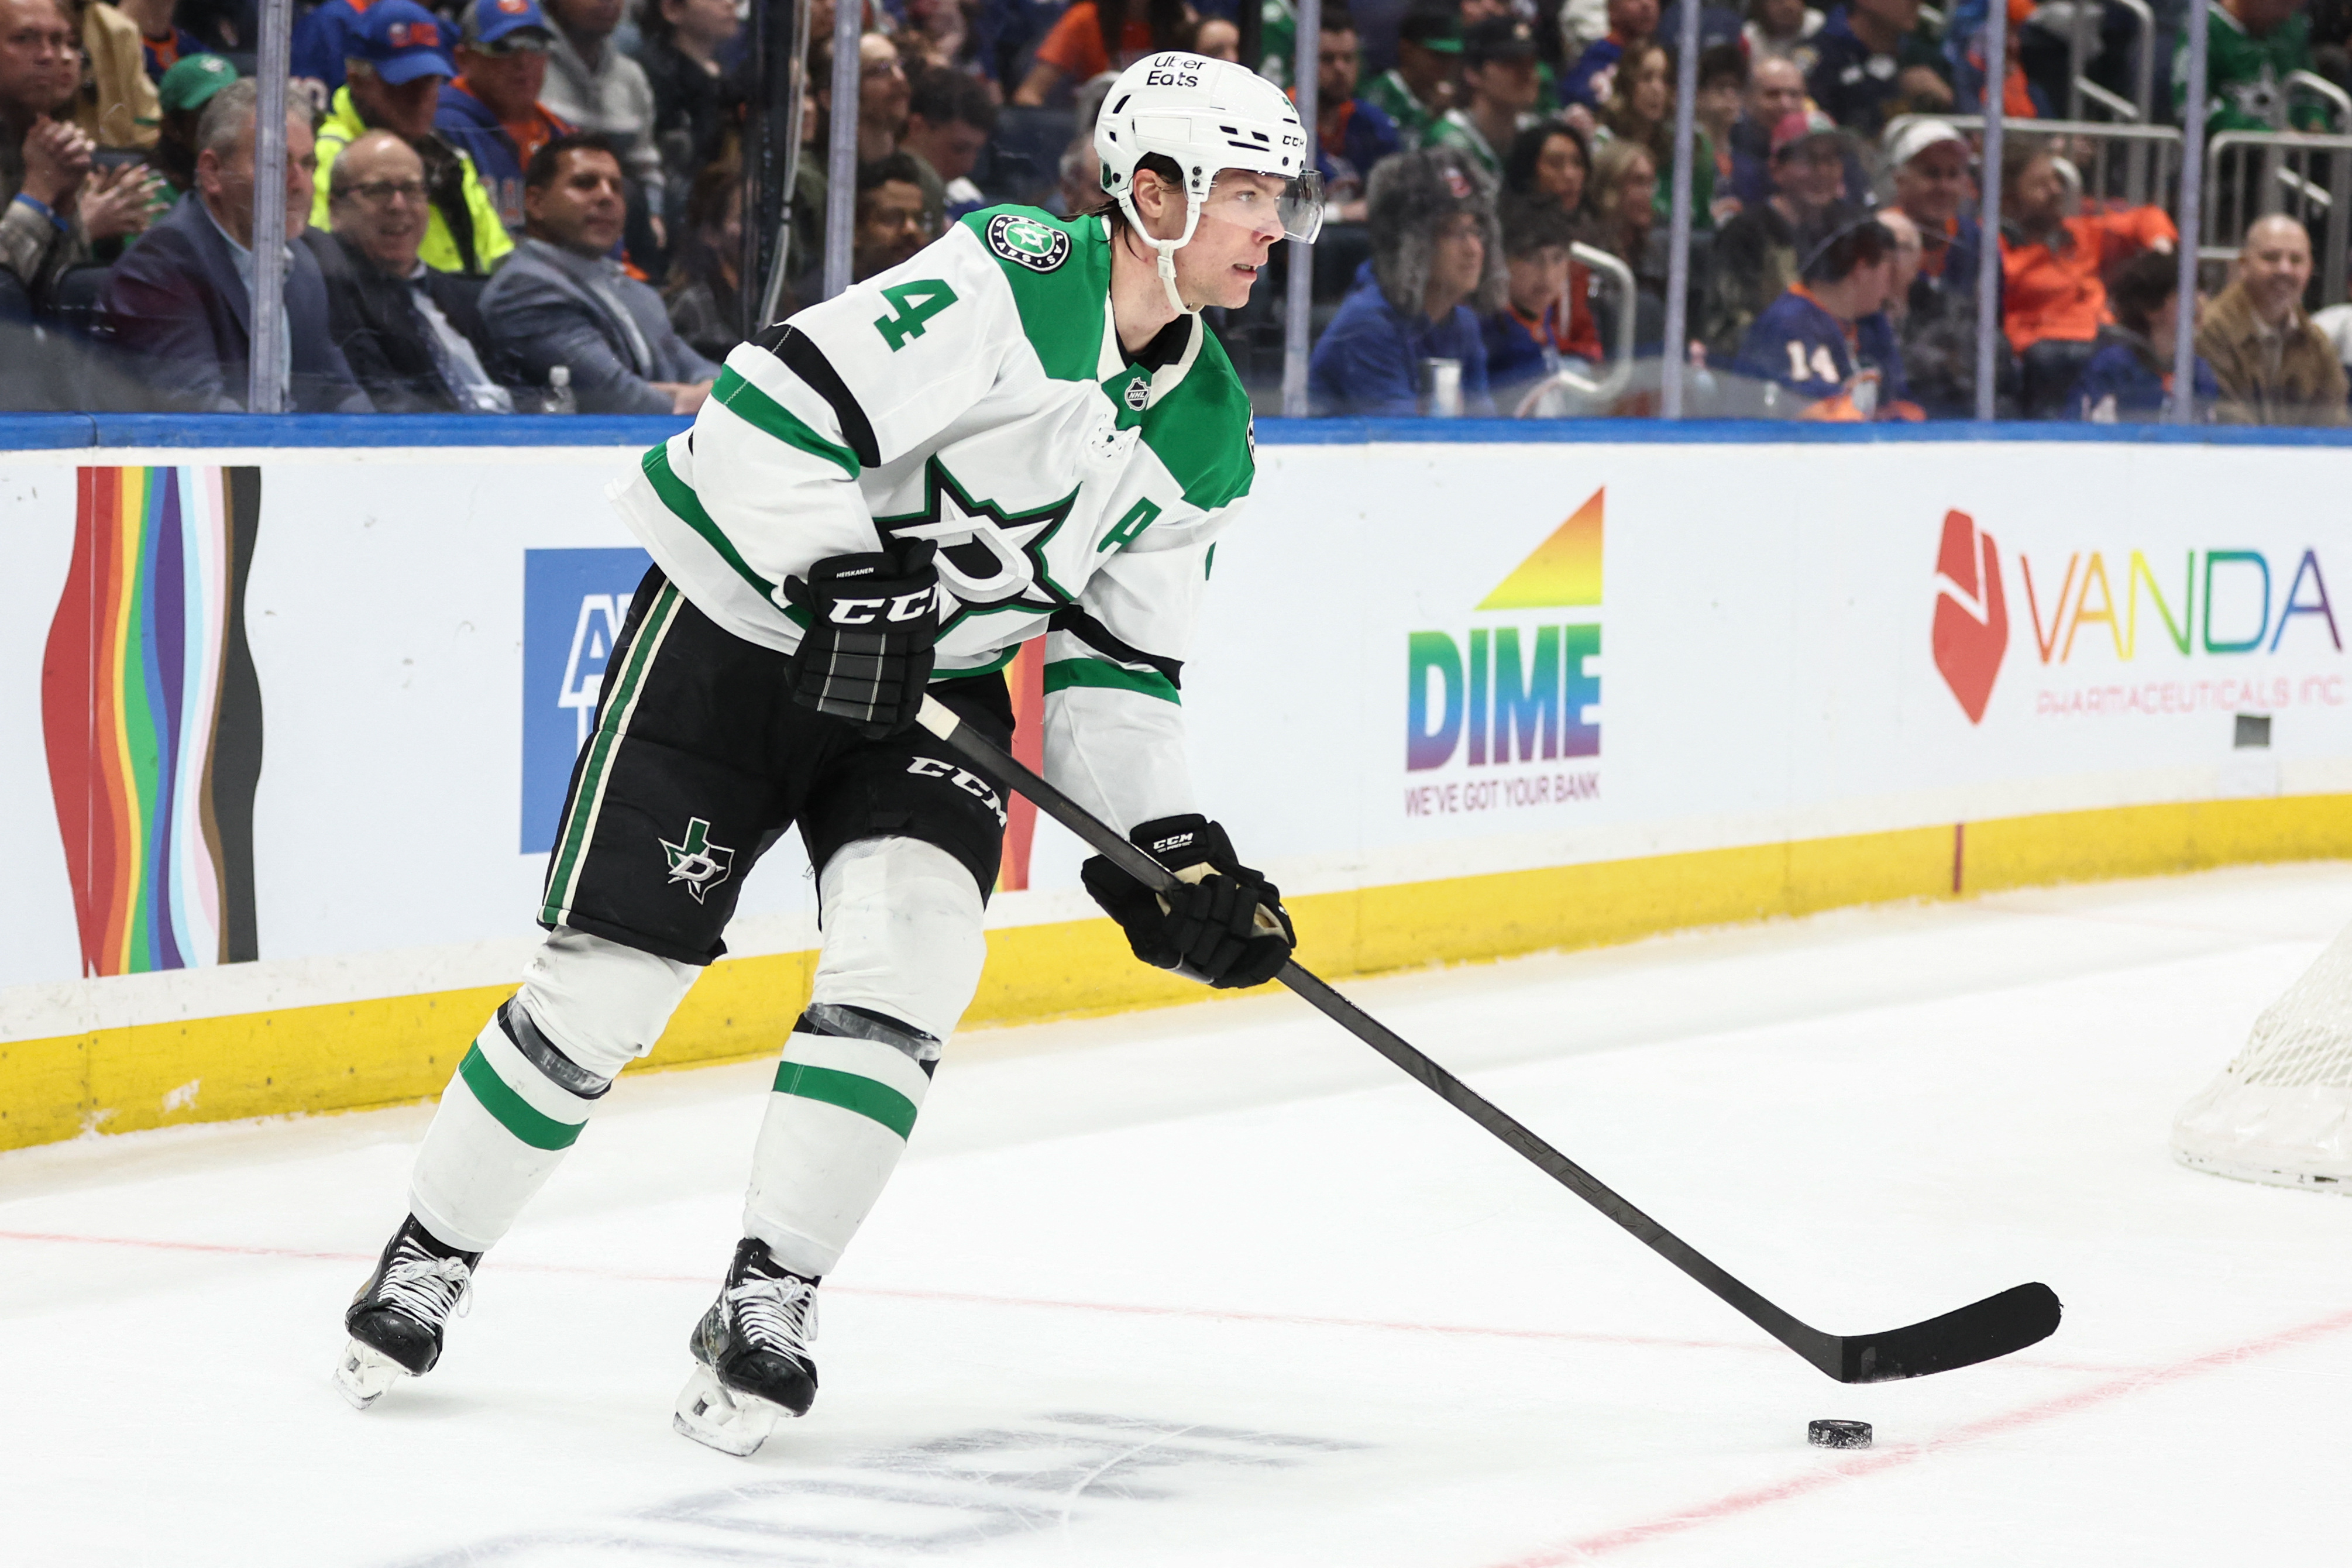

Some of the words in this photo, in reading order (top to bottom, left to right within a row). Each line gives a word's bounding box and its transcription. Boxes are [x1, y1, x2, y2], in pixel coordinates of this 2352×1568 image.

[1146, 70, 1198, 87] Eats
[1154, 56, 1206, 70] Uber
[993, 219, 1031, 263] STARS
[874, 278, 959, 353] 4
[1786, 340, 1839, 383] 14
[1096, 496, 1162, 556] A
[836, 567, 874, 579] HEISKANEN
[2019, 548, 2343, 665] VANDA
[1406, 623, 1601, 772] DIME
[2036, 677, 2291, 715] PHARMACEUTICALS
[906, 757, 1007, 827] CCM
[1405, 782, 1459, 817] WE'VE
[1464, 779, 1498, 811] GOT
[1504, 776, 1549, 808] YOUR
[1555, 771, 1600, 803] BANK
[1153, 833, 1194, 850] CCM
